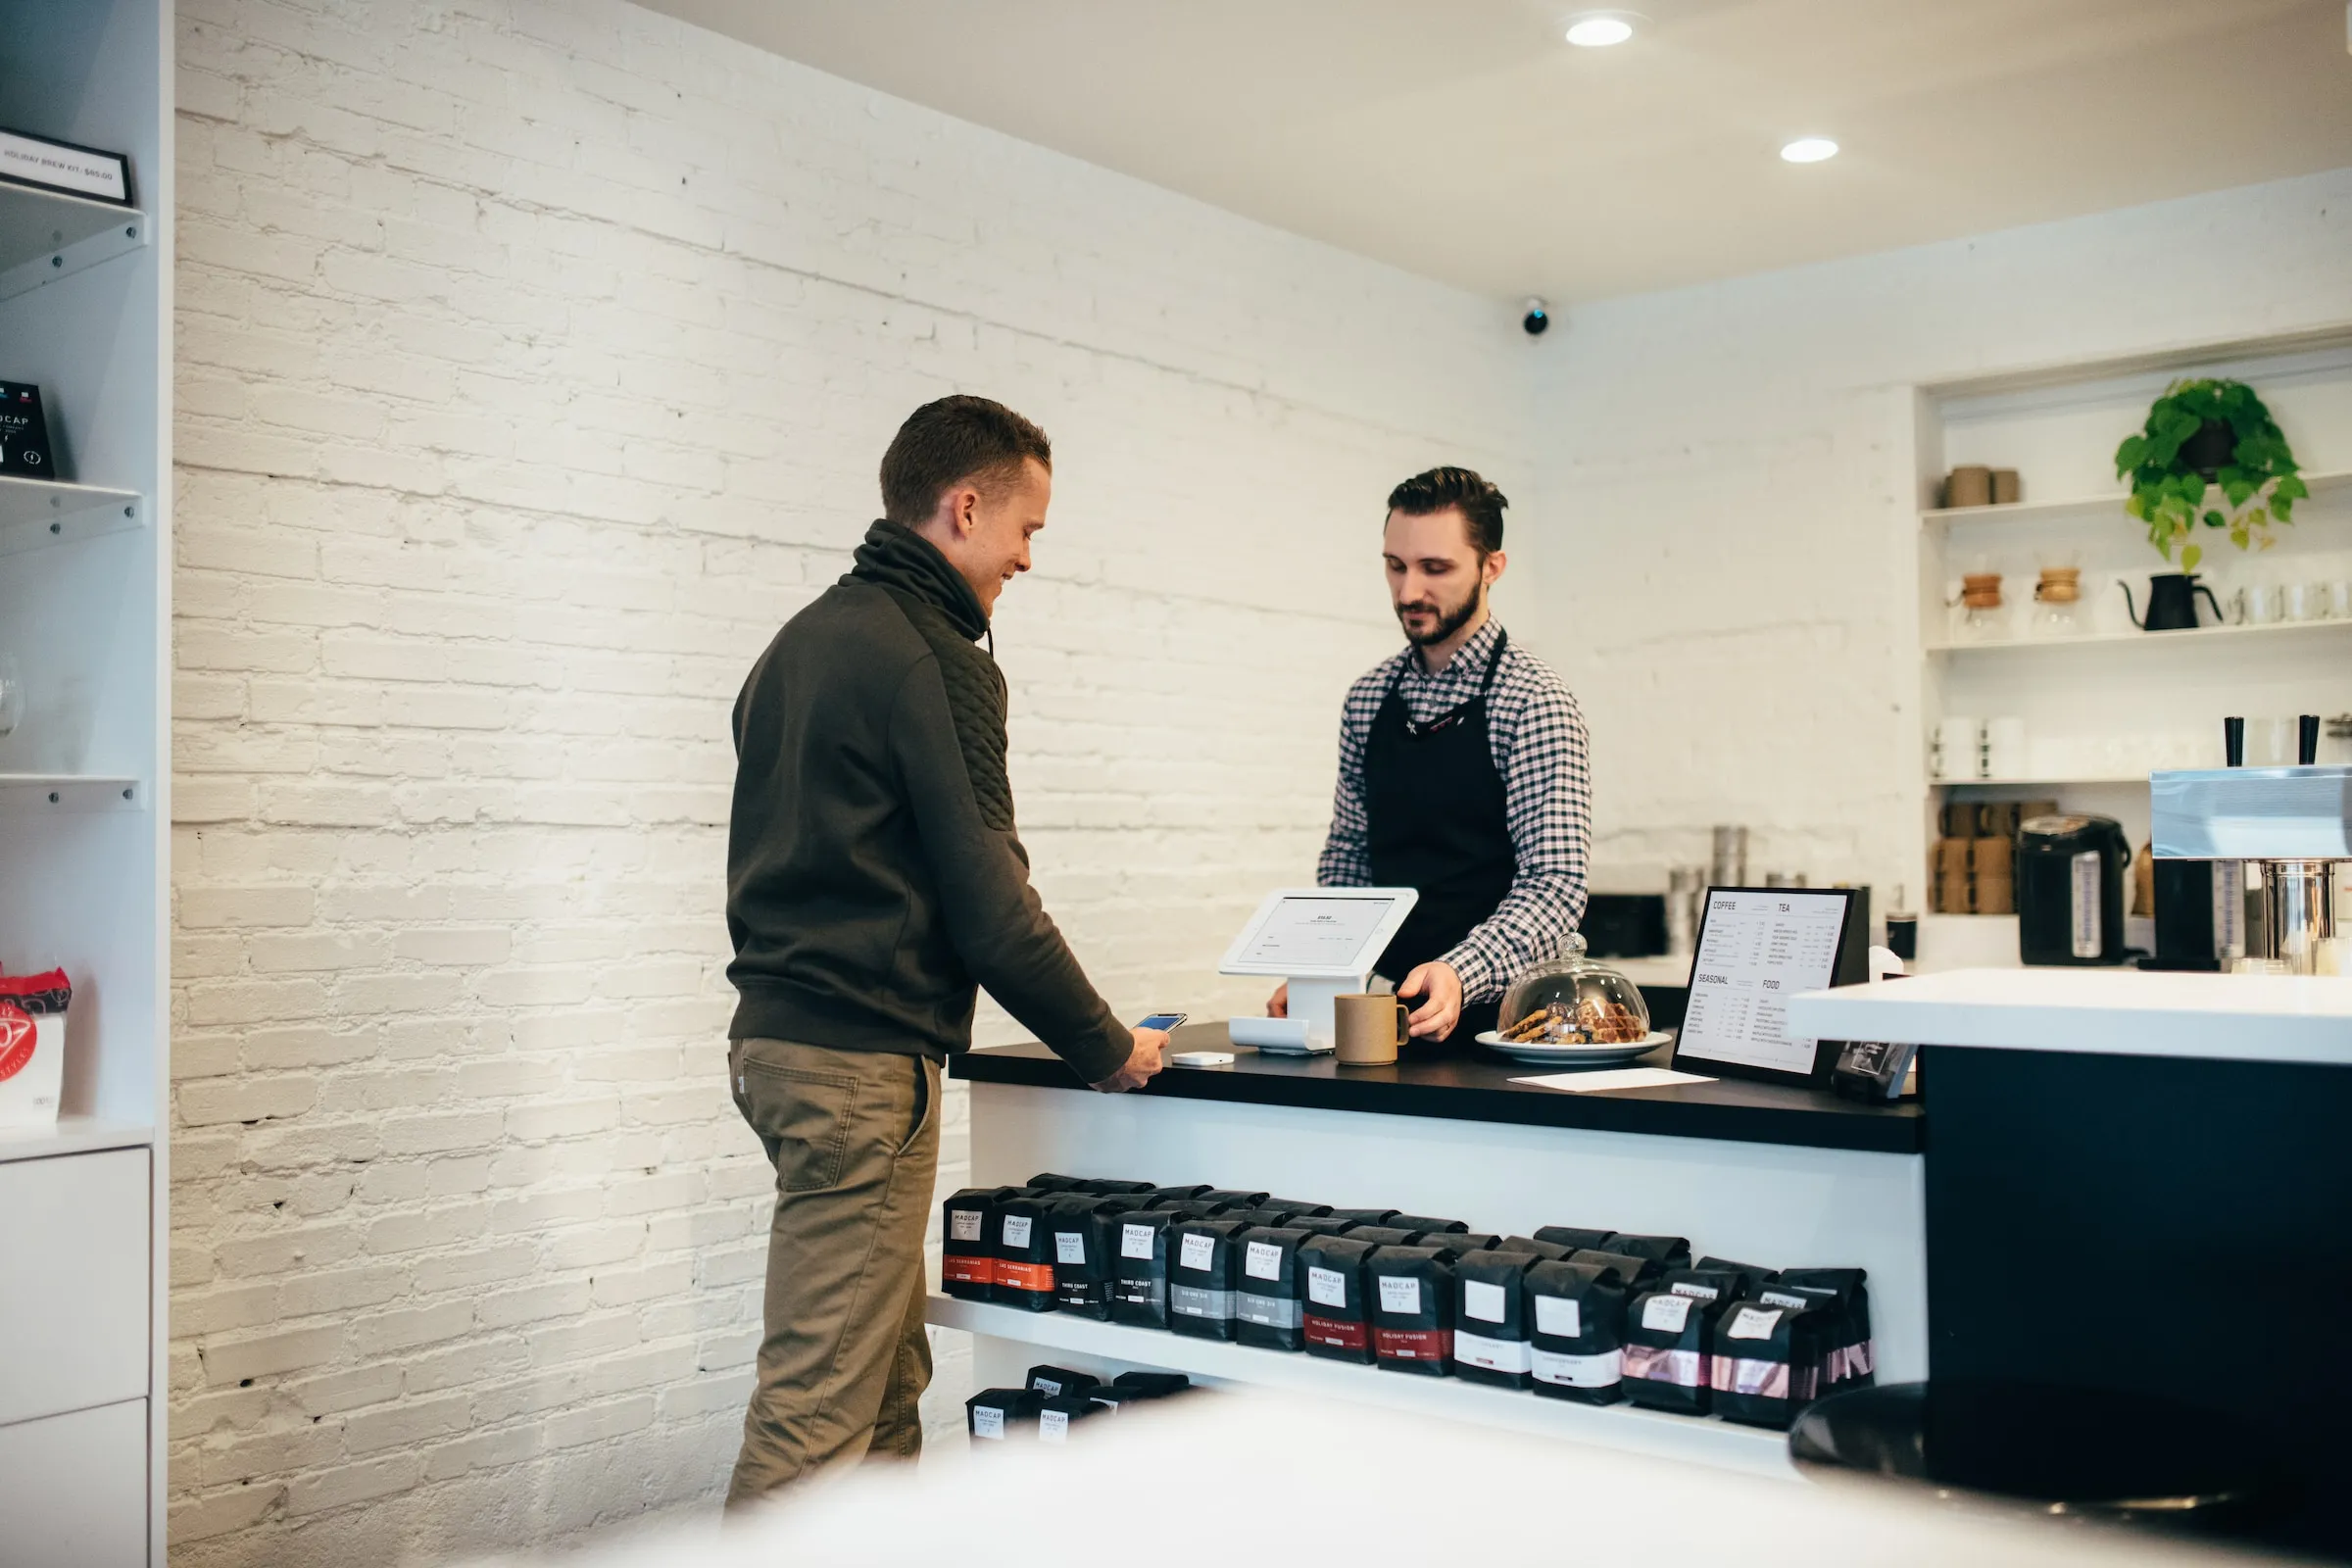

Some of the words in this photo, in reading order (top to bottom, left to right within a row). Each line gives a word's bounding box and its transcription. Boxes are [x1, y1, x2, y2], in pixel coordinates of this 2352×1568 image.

[4, 149, 39, 164] HOLIDAY
[41, 158, 65, 170] BREW
[1713, 901, 1736, 910] COFFEE
[1779, 904, 1790, 912] TEA
[1698, 973, 1729, 985] SEASONAL
[1762, 979, 1781, 990] FOOD
[1125, 1229, 1152, 1238] MADCAP
[1185, 1238, 1212, 1249] MADCAP
[1249, 1246, 1279, 1257] MADCAP
[1311, 1272, 1342, 1284] MADCAP
[1311, 1320, 1333, 1329] HOLIDAY
[1334, 1323, 1355, 1332] FUSION
[1035, 1381, 1058, 1393] MADCAP
[975, 1409, 1002, 1420] MADCAP
[1042, 1413, 1066, 1423] MADCAP
